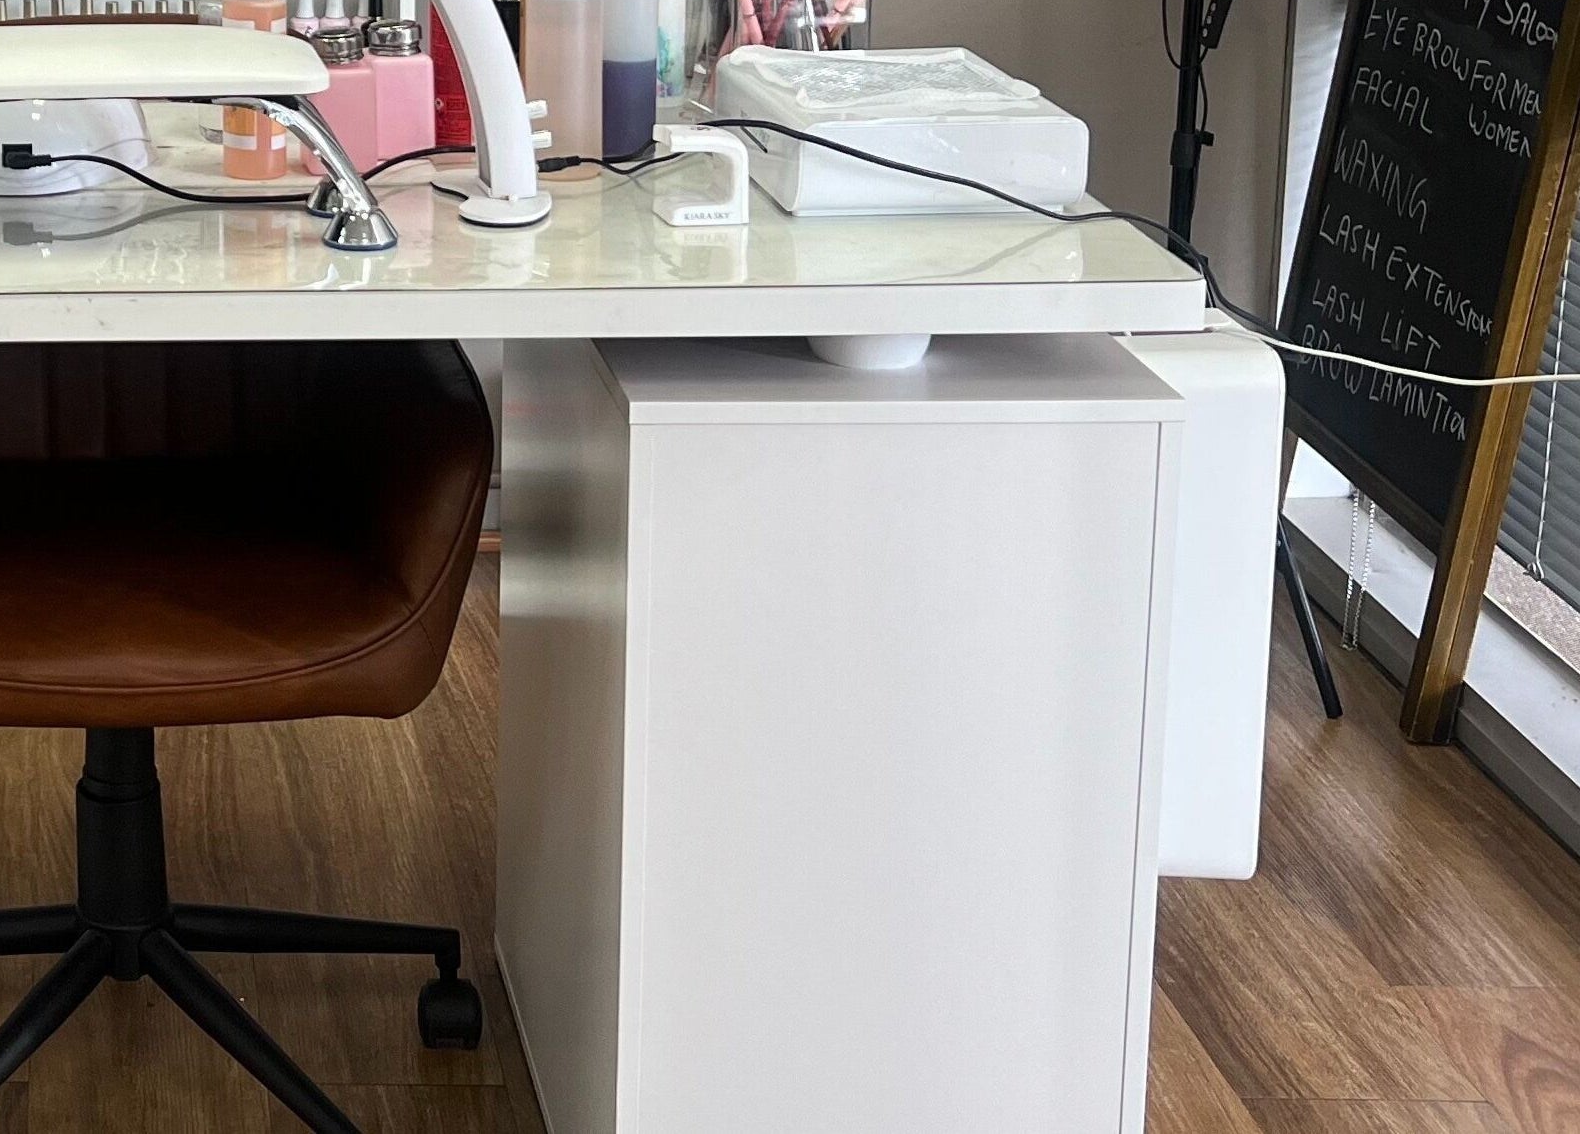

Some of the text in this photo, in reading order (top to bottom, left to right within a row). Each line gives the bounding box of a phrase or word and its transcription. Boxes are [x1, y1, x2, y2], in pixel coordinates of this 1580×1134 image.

[1412, 23, 1470, 82] BROW
[1350, 66, 1433, 135] FACIAL
[1333, 127, 1429, 235] WAXING
[1319, 204, 1381, 271] LASH
[1312, 278, 1366, 335] LASH
[1299, 323, 1364, 395] BROW
